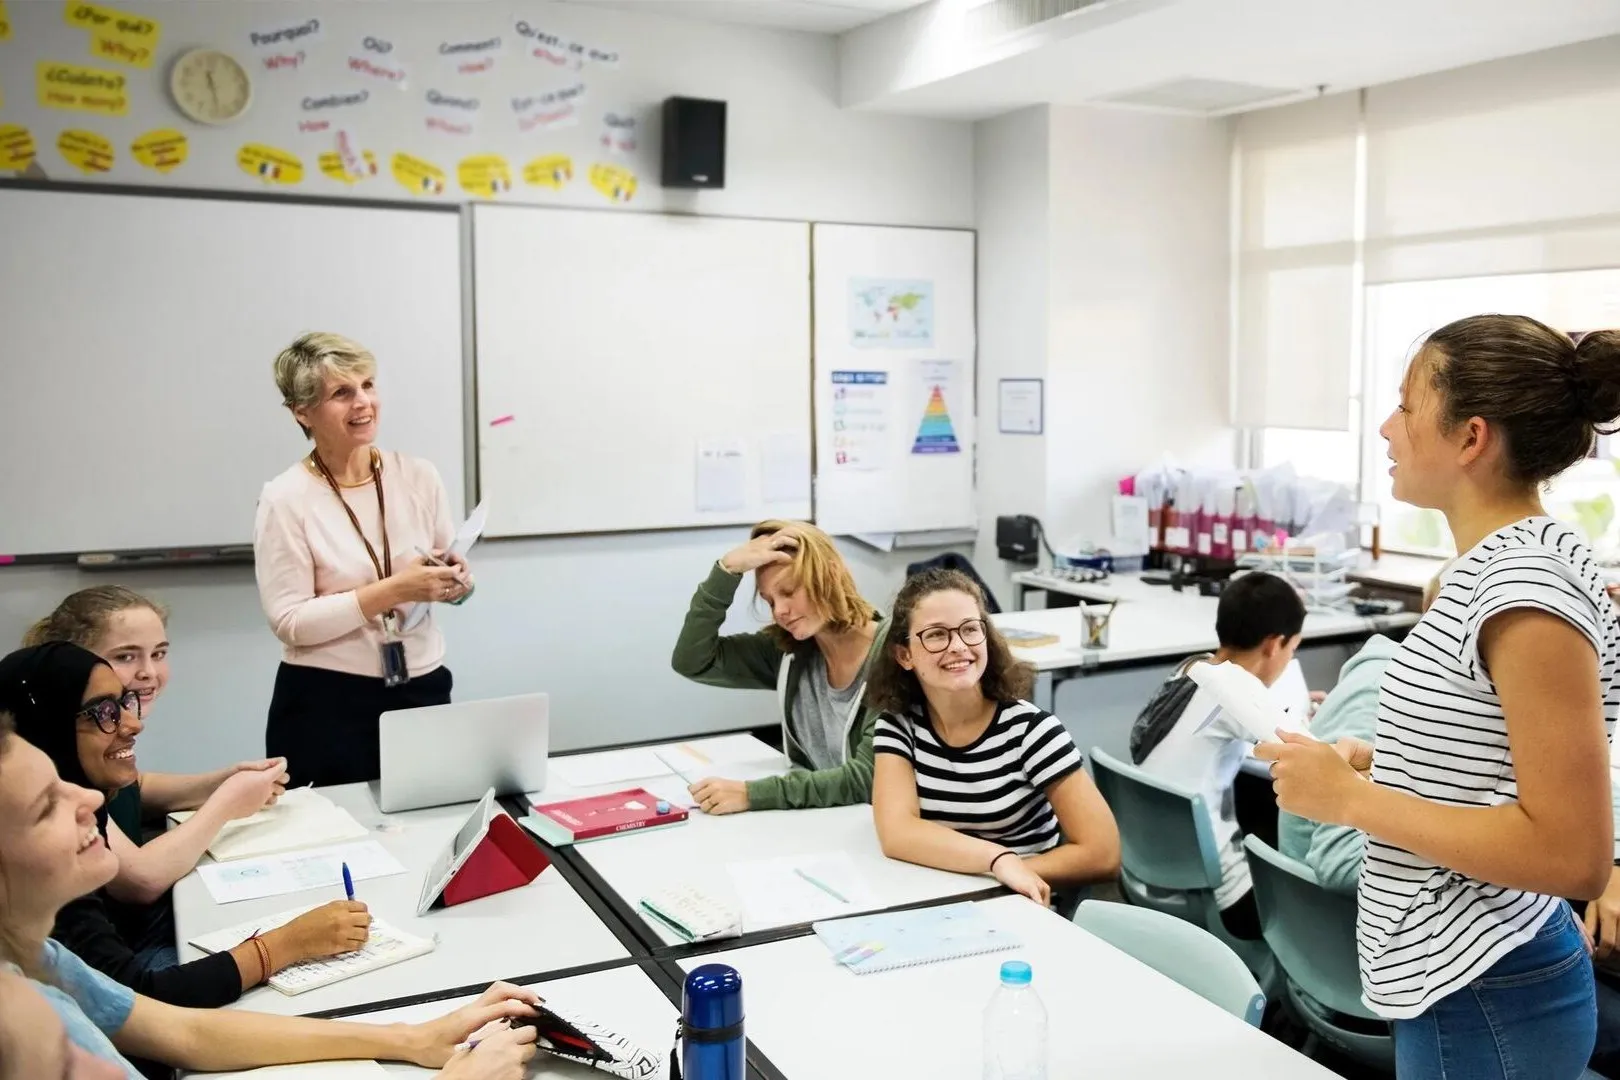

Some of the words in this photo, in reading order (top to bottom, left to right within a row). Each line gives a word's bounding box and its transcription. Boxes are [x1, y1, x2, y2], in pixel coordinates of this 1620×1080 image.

[249, 19, 320, 46] Pourquoi?
[99, 38, 149, 62] Why?
[262, 51, 306, 70] Why?
[615, 821, 646, 832] CHEMISTRY
